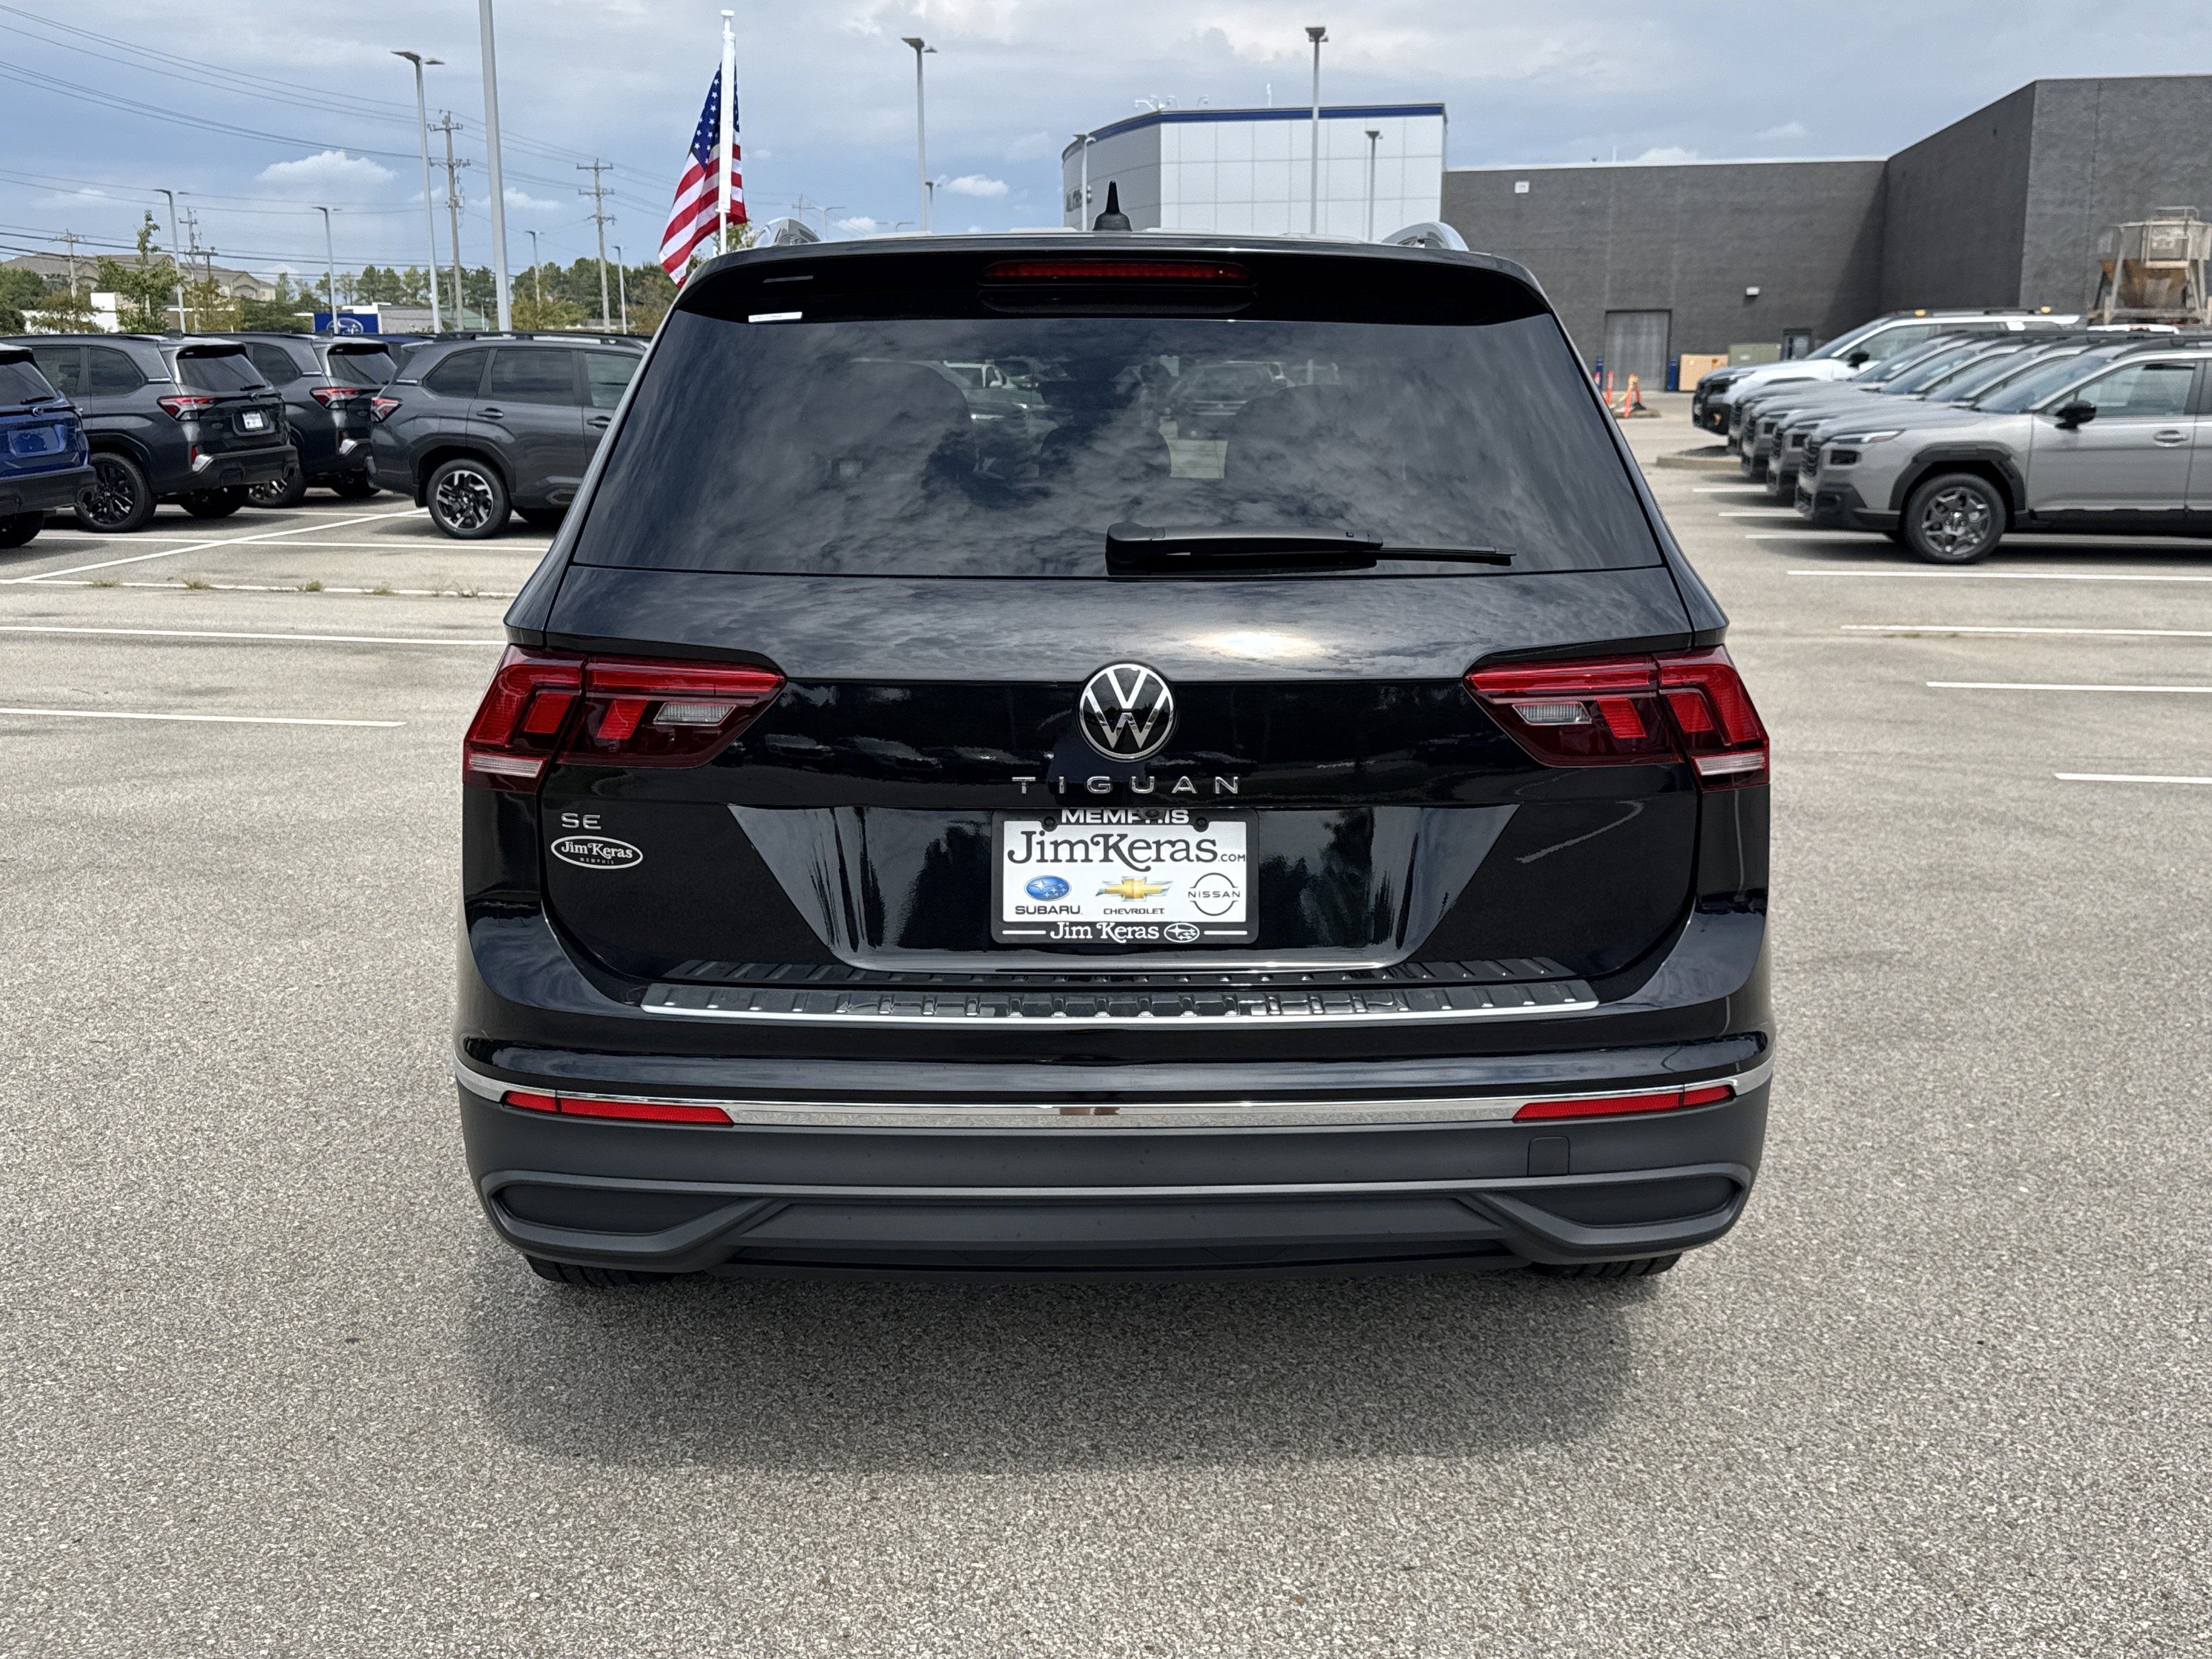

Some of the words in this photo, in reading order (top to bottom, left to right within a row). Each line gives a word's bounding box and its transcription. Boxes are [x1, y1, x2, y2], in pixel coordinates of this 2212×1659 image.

[1012, 776, 1239, 794] TIGUAN
[561, 812, 601, 830] SE
[1062, 809, 1189, 823] MEMPIS
[1015, 905, 1081, 915] SUBARU
[1049, 922, 1093, 939] Jim
[1096, 922, 1159, 944] Keras
